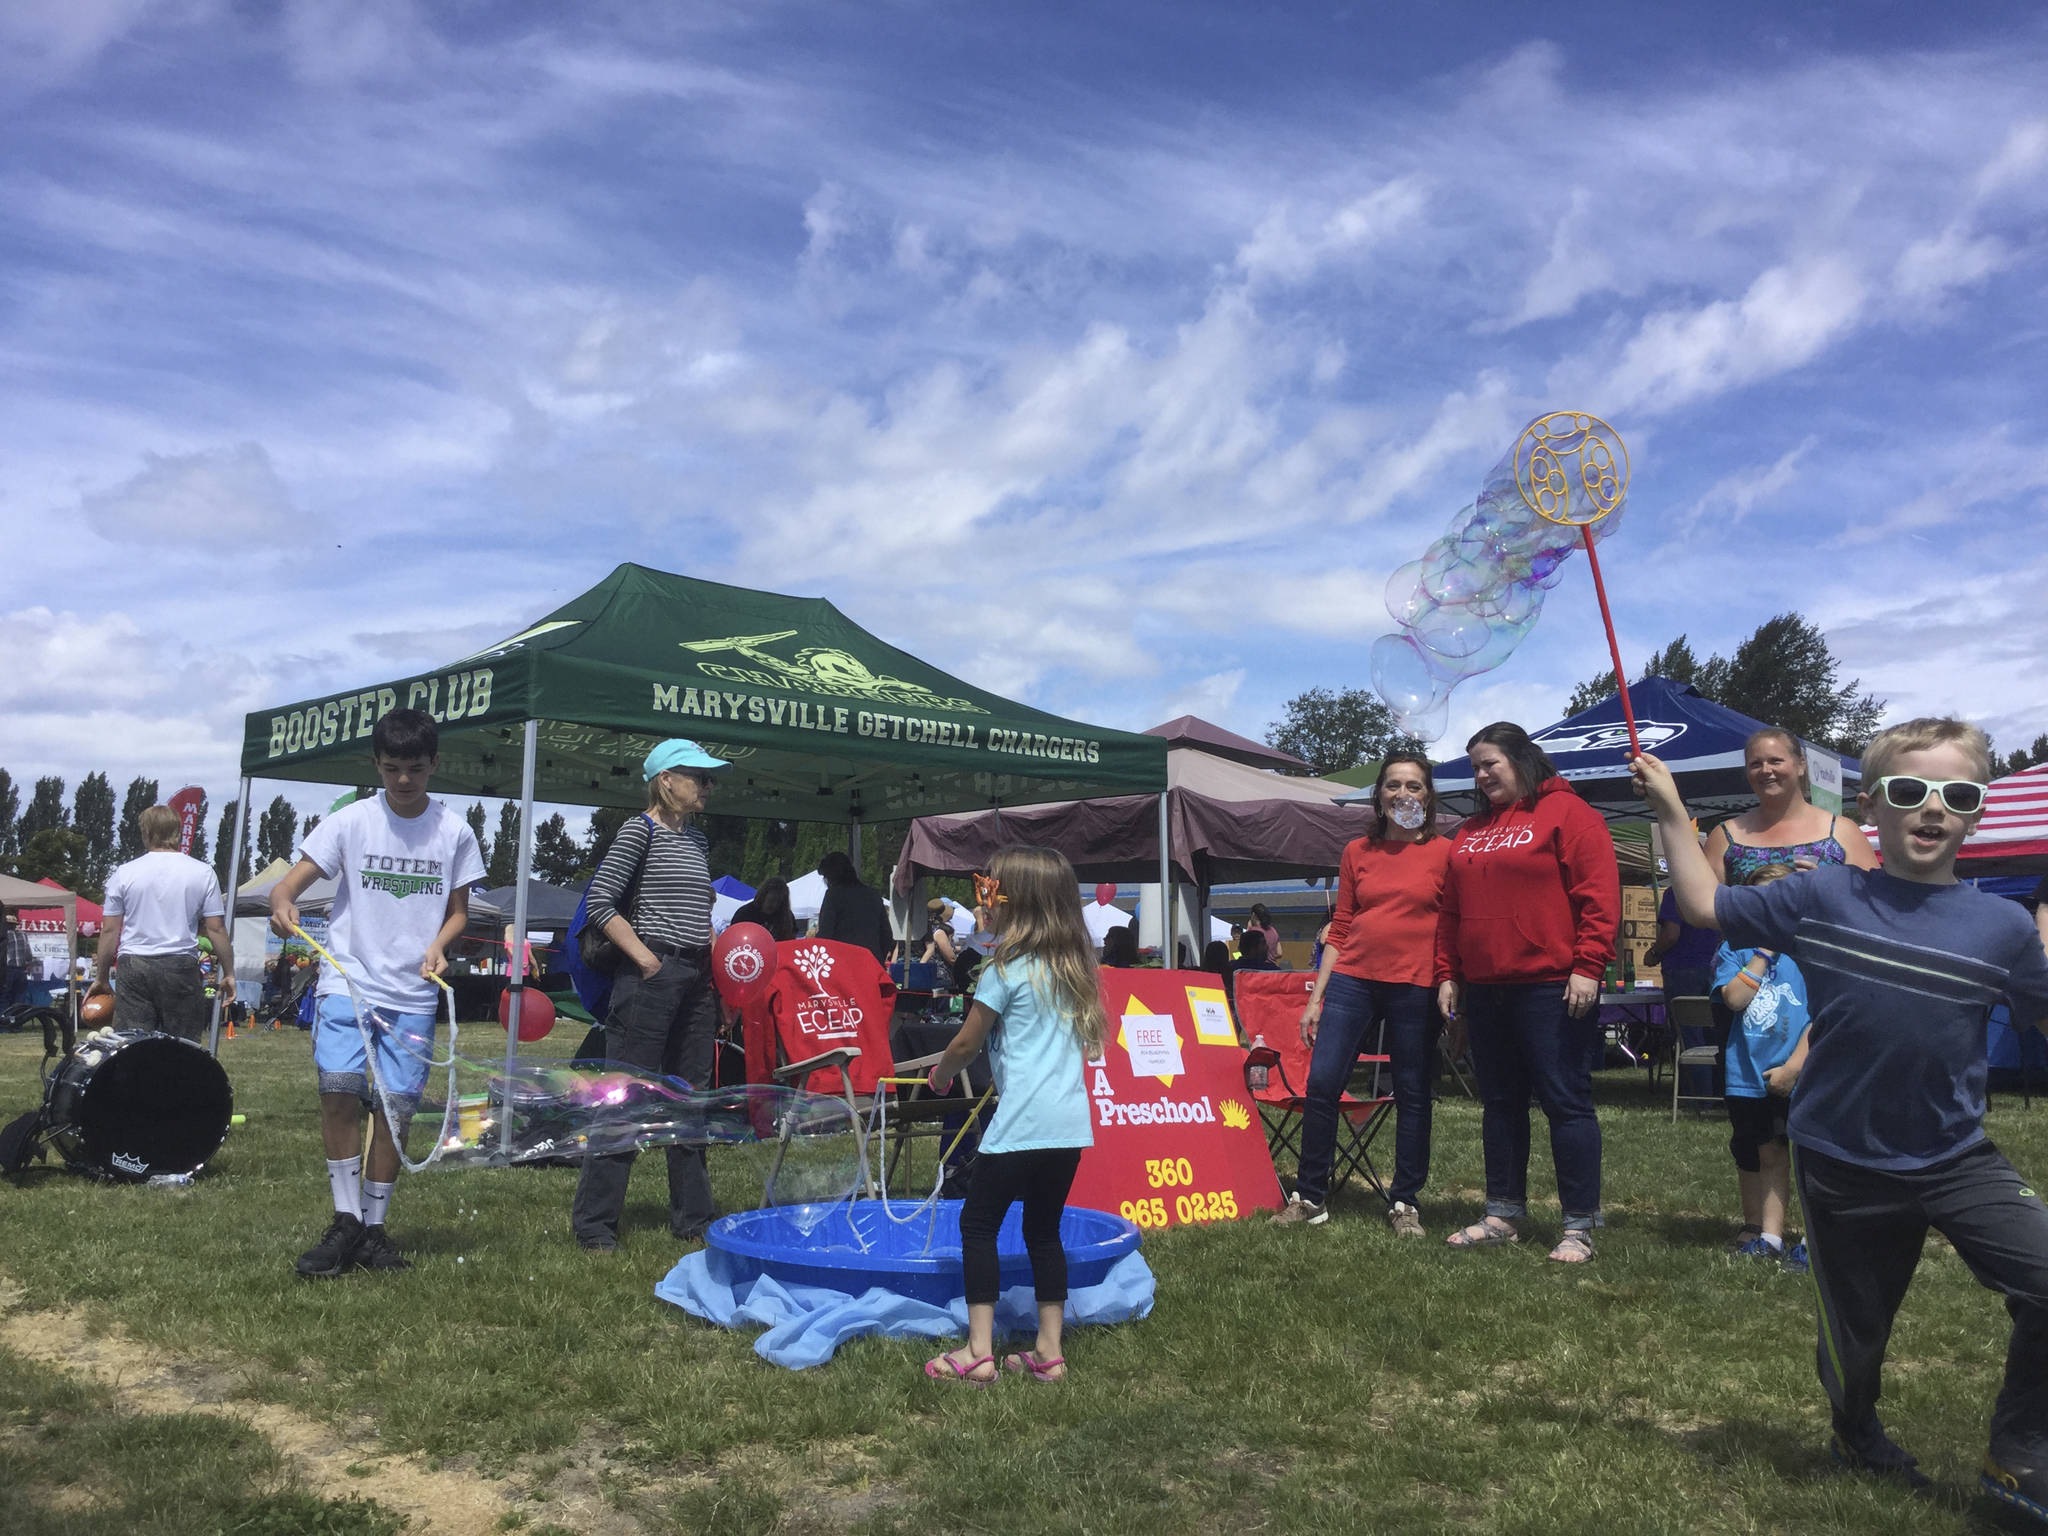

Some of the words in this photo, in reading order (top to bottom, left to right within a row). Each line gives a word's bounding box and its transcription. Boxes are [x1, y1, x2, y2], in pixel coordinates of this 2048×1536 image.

[268, 688, 397, 759] BOOSTER
[408, 668, 494, 724] CLUB
[652, 682, 849, 734] MARYSVILLE
[856, 710, 980, 750] GETCHELL
[986, 728, 1101, 764] CHARGERS
[363, 854, 443, 876] TOTEM
[361, 875, 444, 896] WRESTLING
[797, 997, 857, 1011] MARYSVILLE
[796, 1007, 864, 1034] ECEAP
[1136, 1029, 1163, 1044] FREE
[1092, 1068, 1115, 1097] A
[1095, 1095, 1216, 1127] Preschool
[115, 1158, 143, 1172] REMO
[1144, 1157, 1194, 1189] 360
[1119, 1197, 1168, 1228] 965
[1175, 1190, 1239, 1225] 0225
